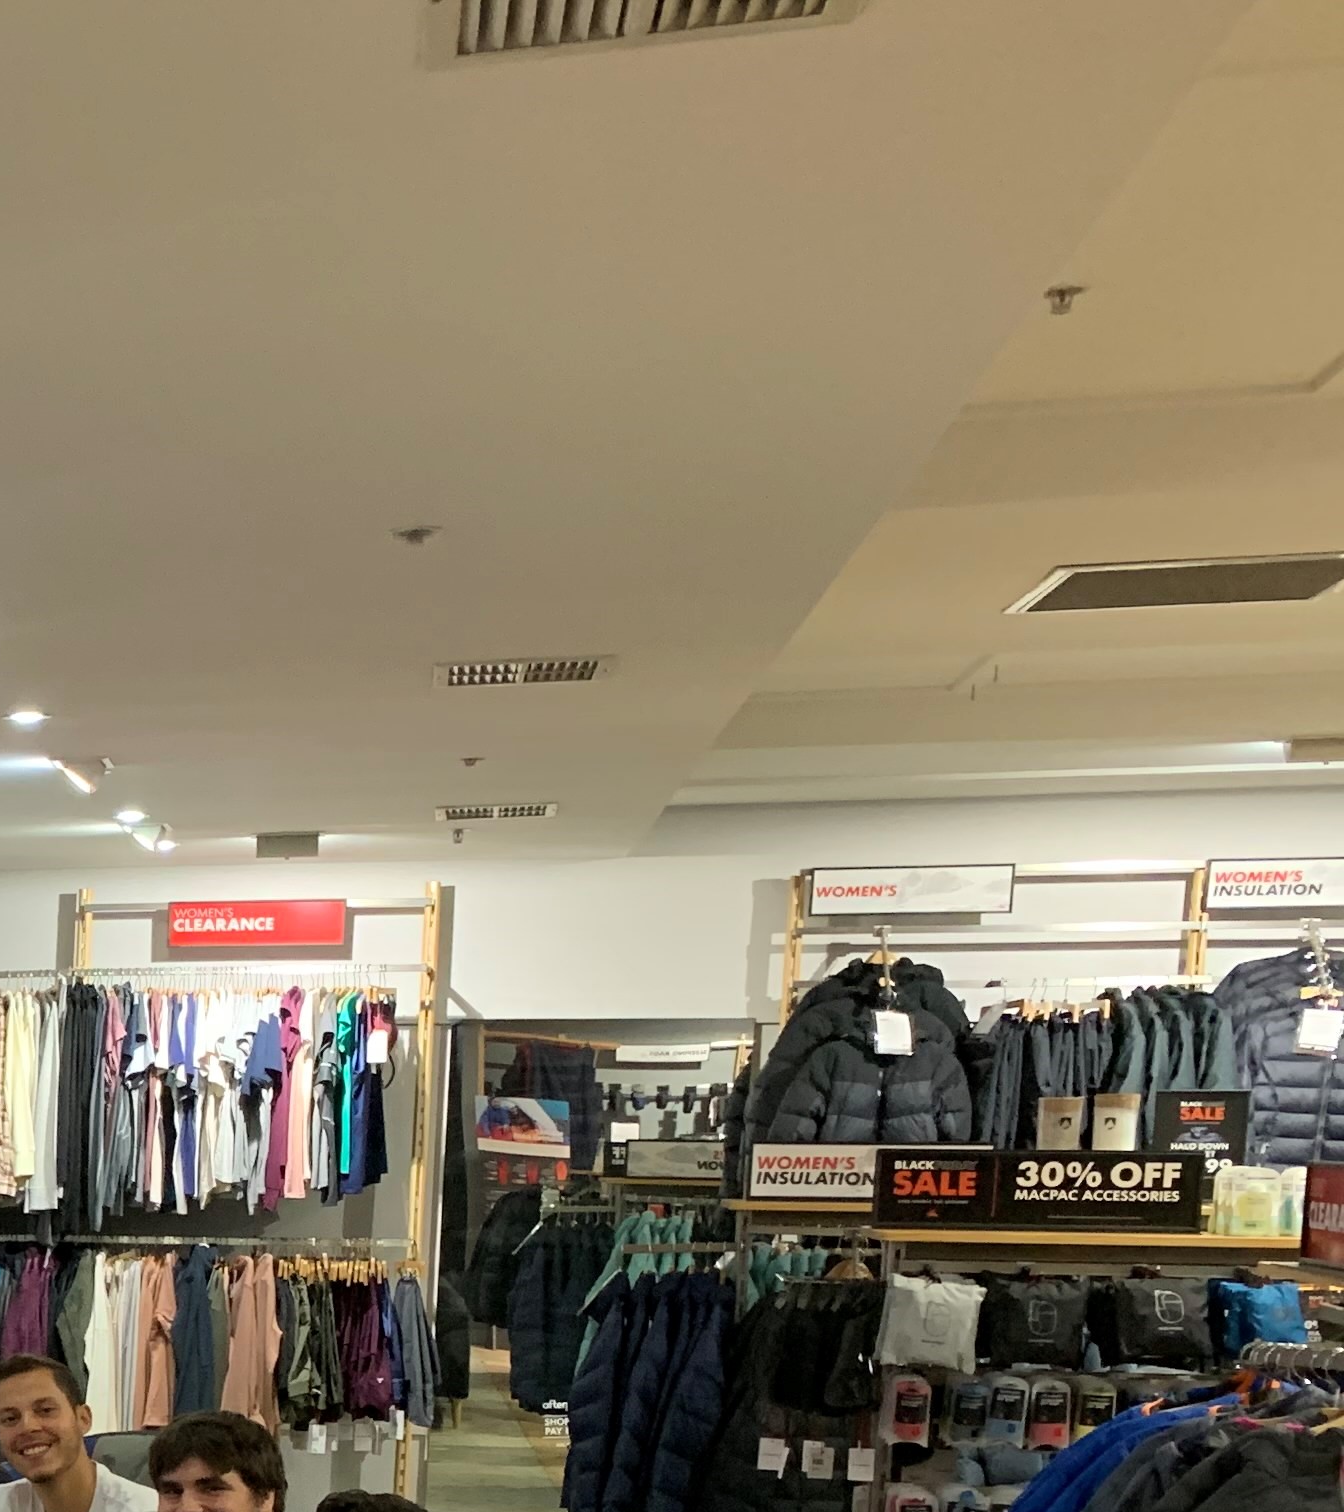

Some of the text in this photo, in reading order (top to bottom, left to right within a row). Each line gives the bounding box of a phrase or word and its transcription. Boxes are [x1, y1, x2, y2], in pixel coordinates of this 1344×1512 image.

[1215, 870, 1304, 884] WOMEN'S
[815, 885, 897, 898] WOMEN'S
[1213, 883, 1323, 897] INSULATION
[174, 907, 234, 918] WOMEN'S
[173, 917, 275, 932] CLEARANCE
[1179, 1106, 1226, 1121] SALE
[1198, 1142, 1230, 1151] DOWN
[757, 1156, 856, 1170] WOMEN'S
[894, 1160, 935, 1170] BLACK
[756, 1171, 875, 1186] INSULATION
[1015, 1160, 1183, 1188] 30% OFF
[893, 1170, 977, 1196] SALE
[1014, 1189, 1181, 1203] MACPAC ACCESSORIES
